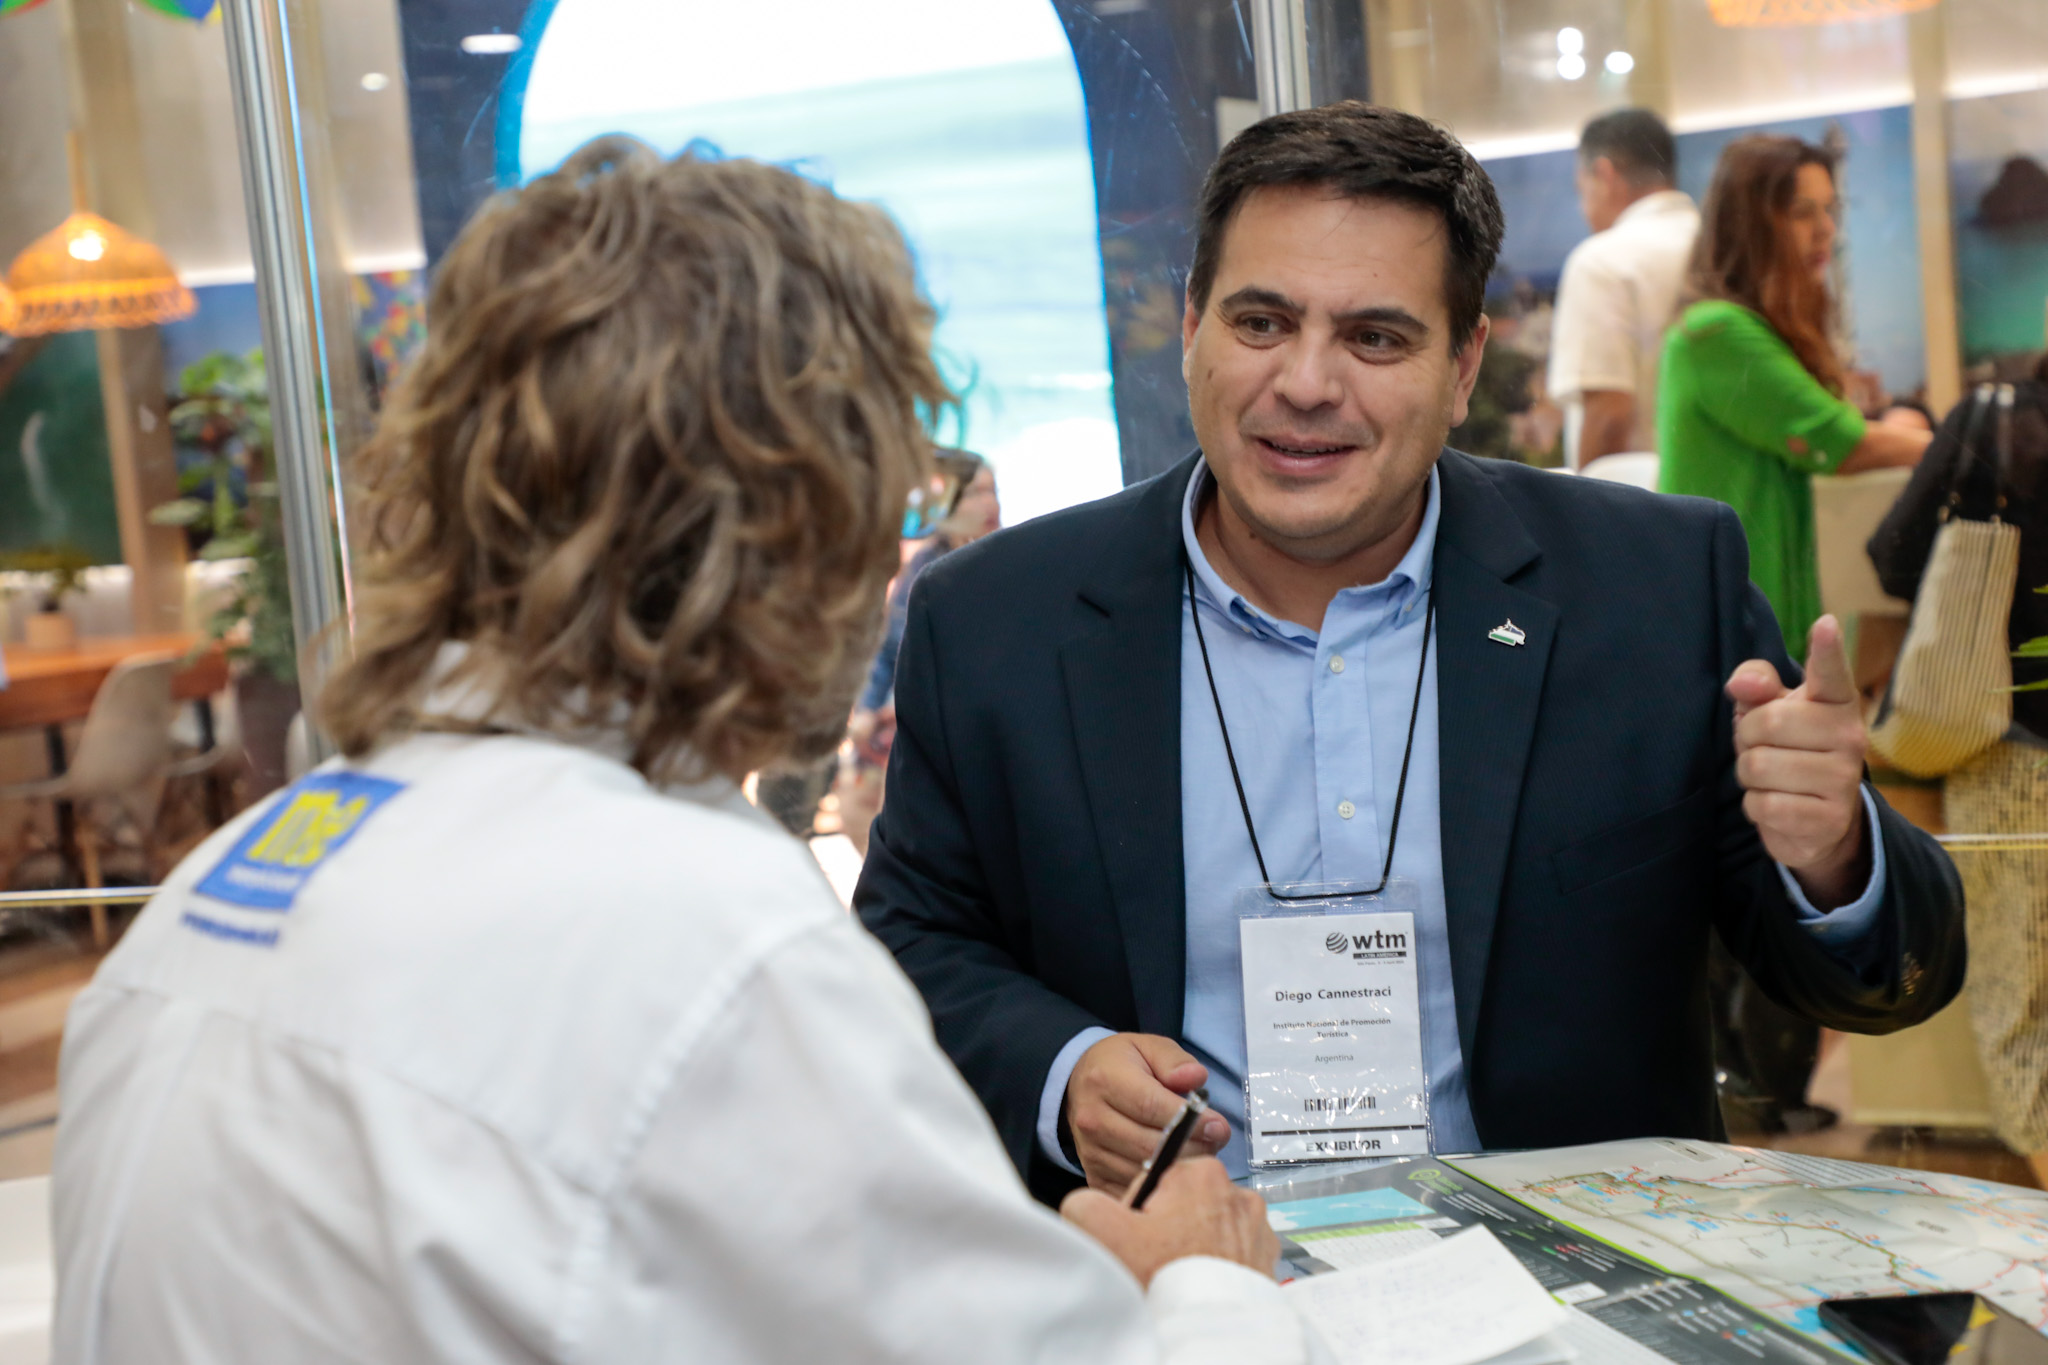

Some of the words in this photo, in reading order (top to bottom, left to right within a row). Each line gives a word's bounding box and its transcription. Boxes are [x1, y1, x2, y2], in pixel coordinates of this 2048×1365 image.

[1352, 930, 1407, 950] wtm
[1275, 990, 1312, 1003] Diego
[1318, 986, 1391, 999] Cannestraci
[1273, 1021, 1305, 1029] Instituto
[1315, 1054, 1354, 1064] Argentina
